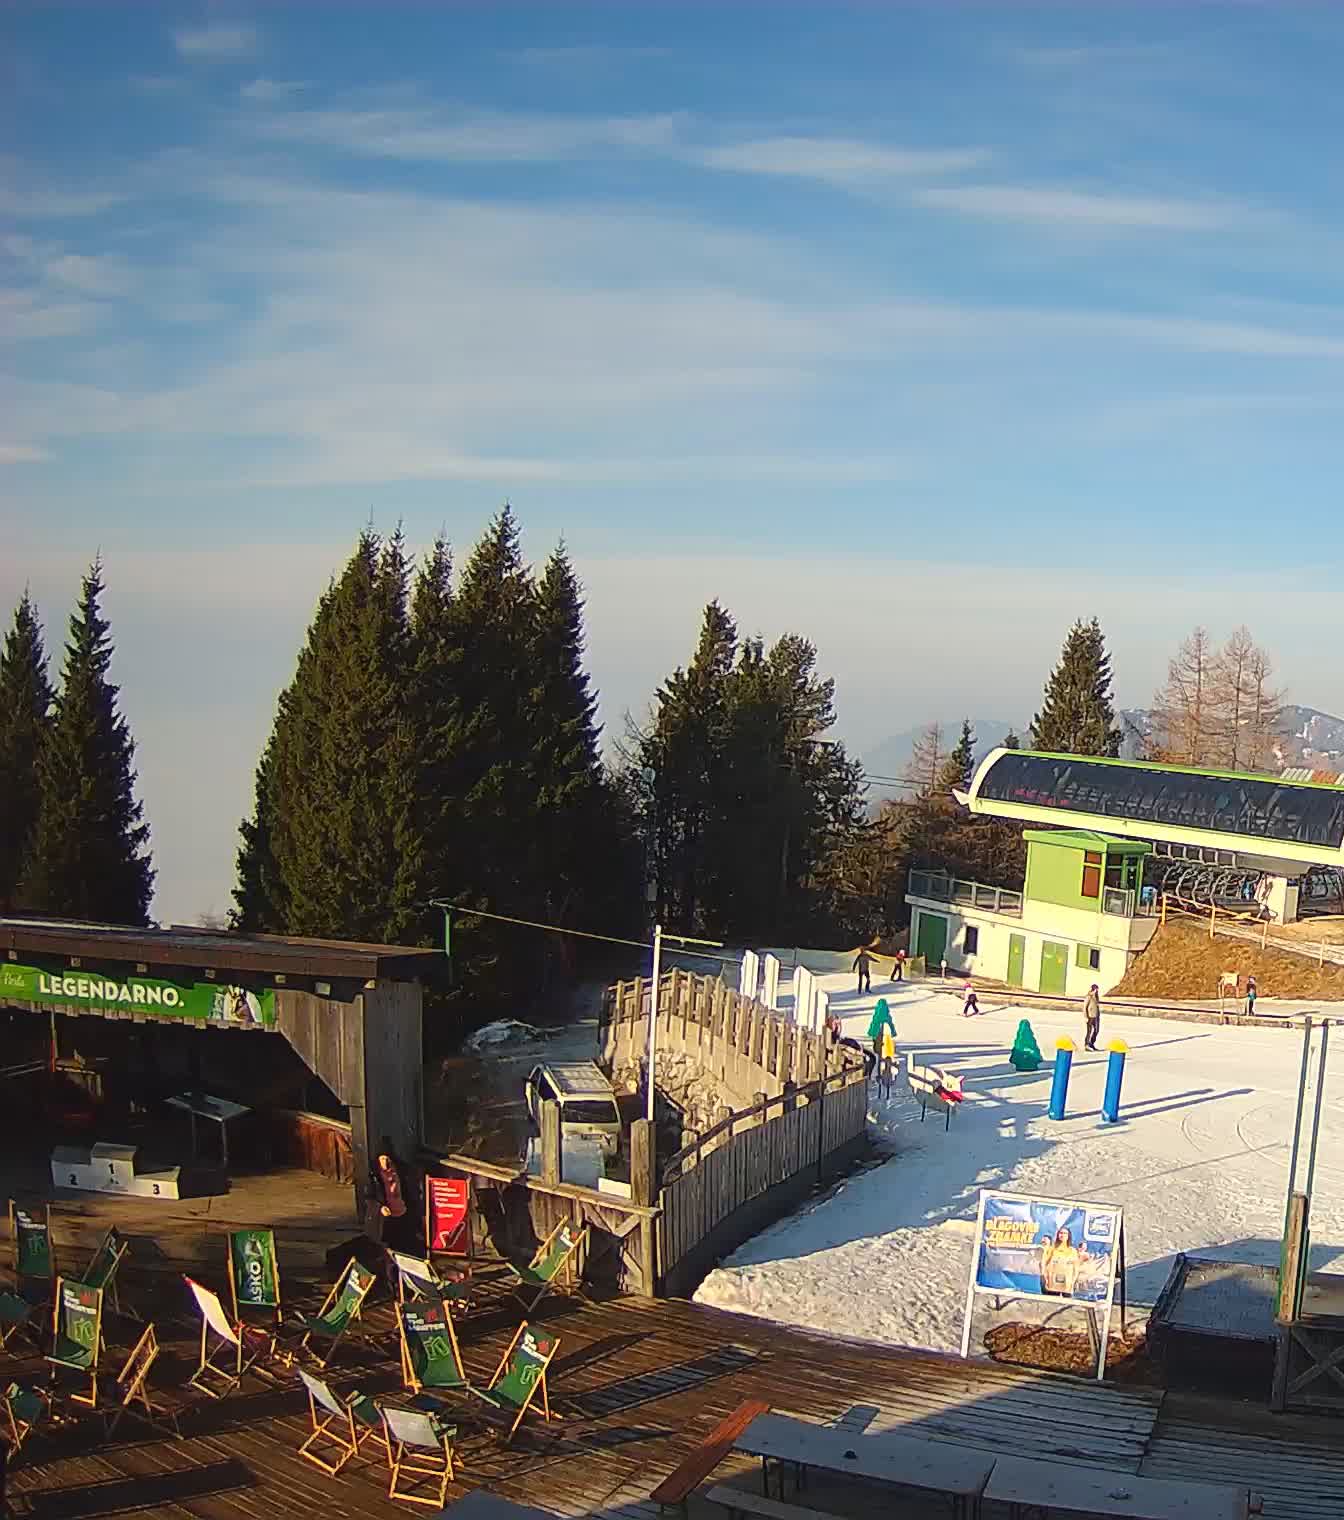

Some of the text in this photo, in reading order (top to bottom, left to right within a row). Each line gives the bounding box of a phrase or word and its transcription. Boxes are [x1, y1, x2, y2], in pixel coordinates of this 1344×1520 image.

[39, 974, 185, 1008] LEGENDARNO.
[108, 1163, 115, 1174] 1
[68, 1173, 79, 1186] 2
[152, 1183, 161, 1195] 3
